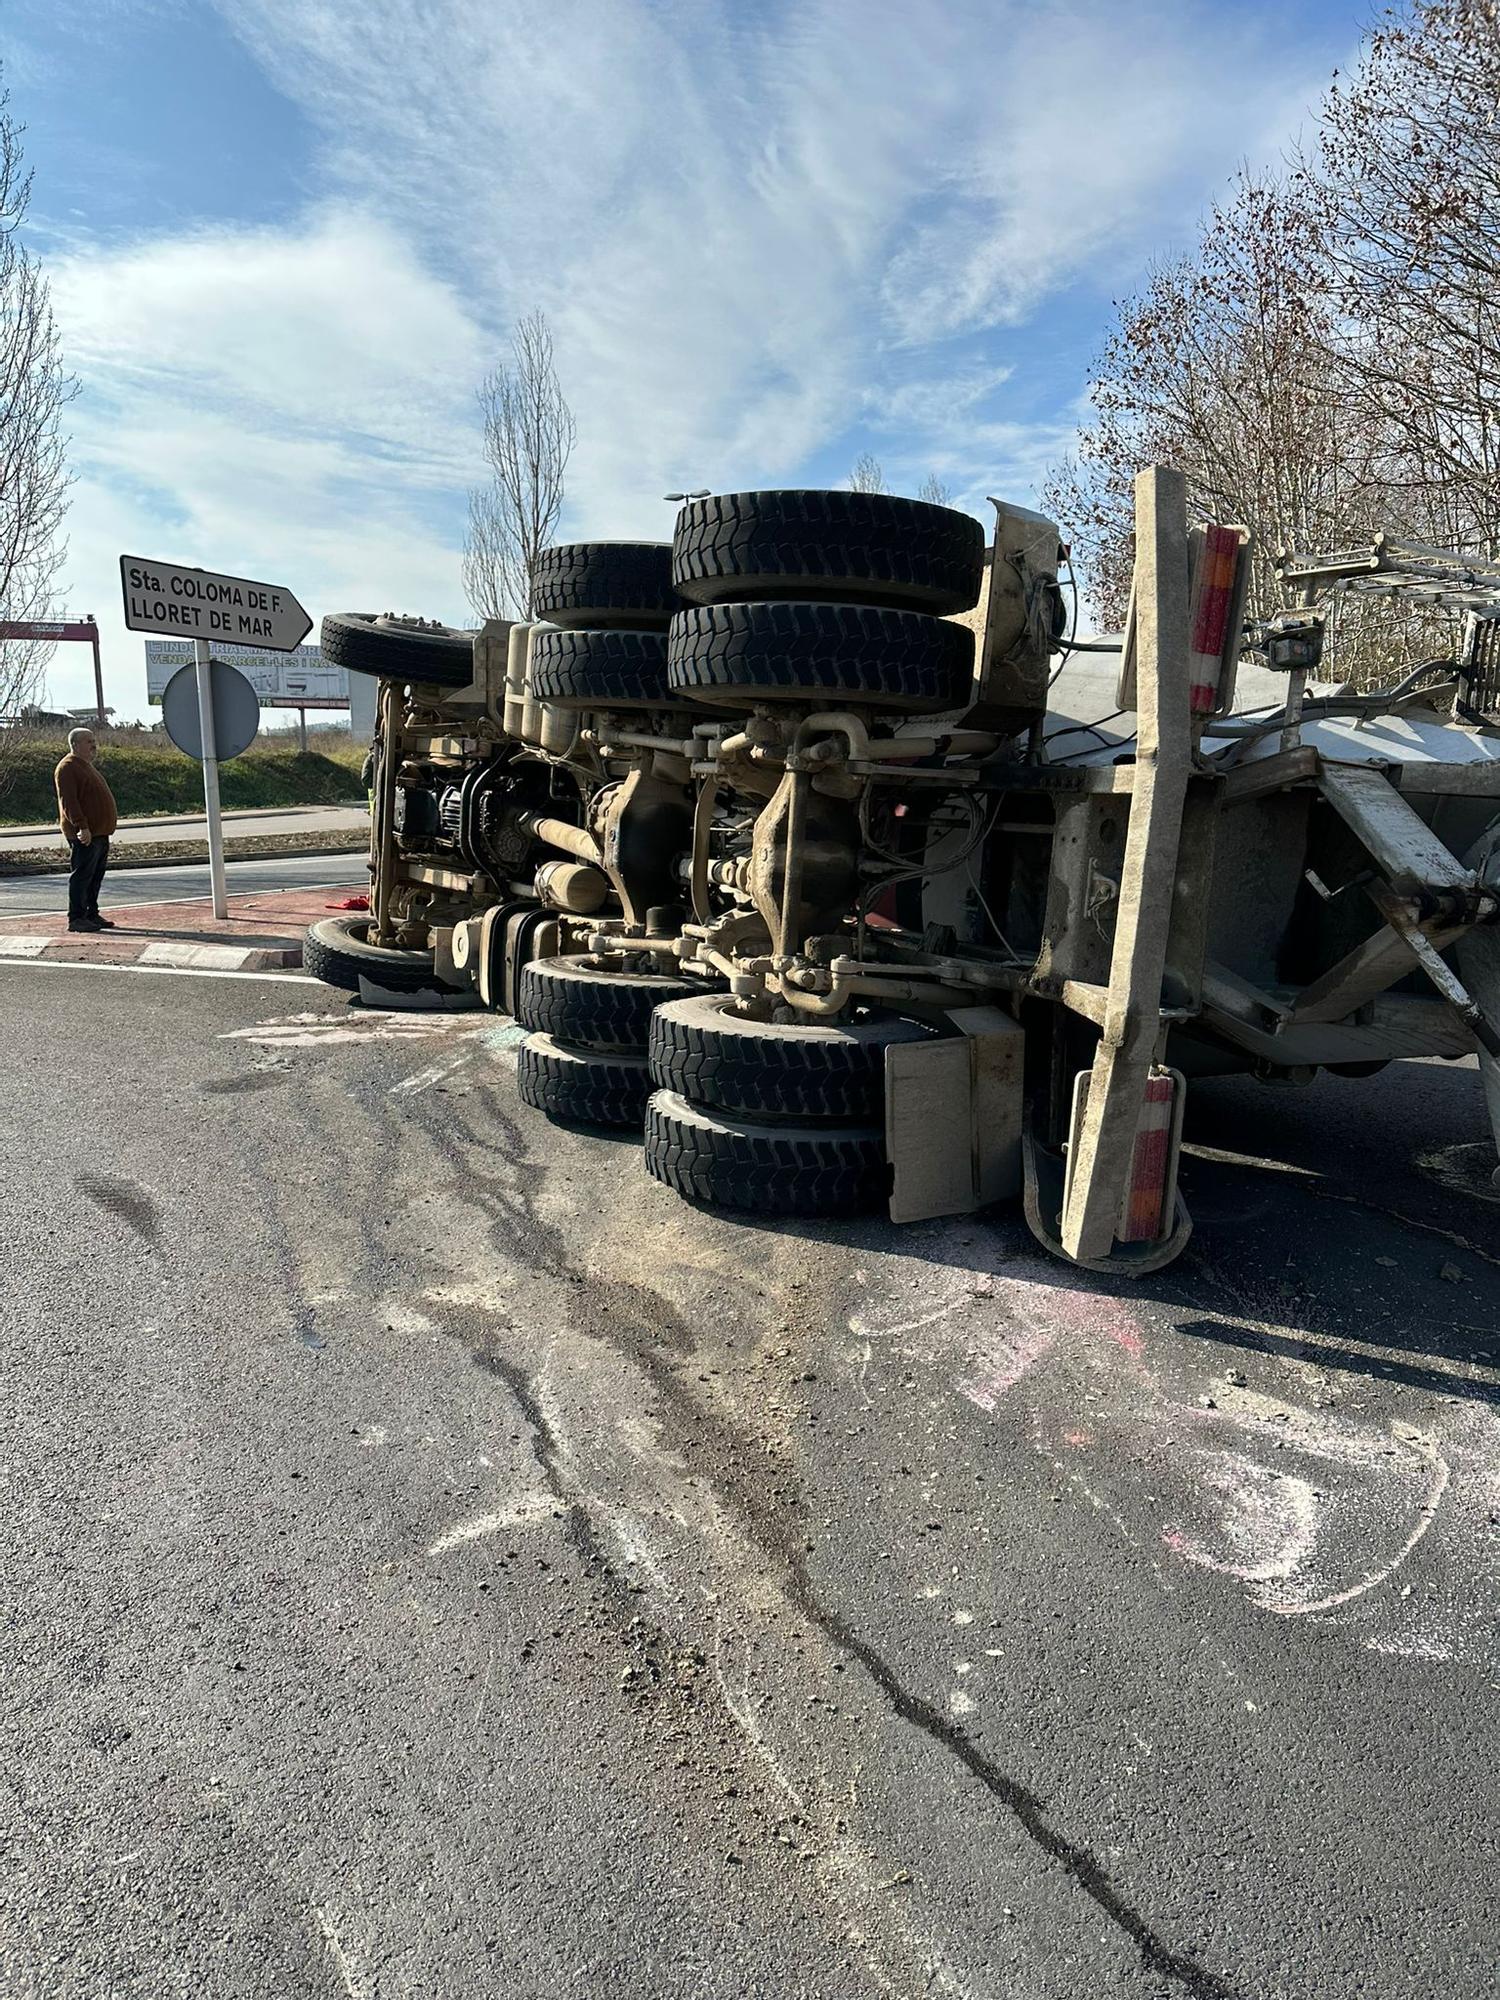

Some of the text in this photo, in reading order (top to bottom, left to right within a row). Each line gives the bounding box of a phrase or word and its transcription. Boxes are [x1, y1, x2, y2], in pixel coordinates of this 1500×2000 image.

[130, 568, 283, 613] Sta. COLOMA DE F.
[132, 597, 273, 637] LLORET DE MAR
